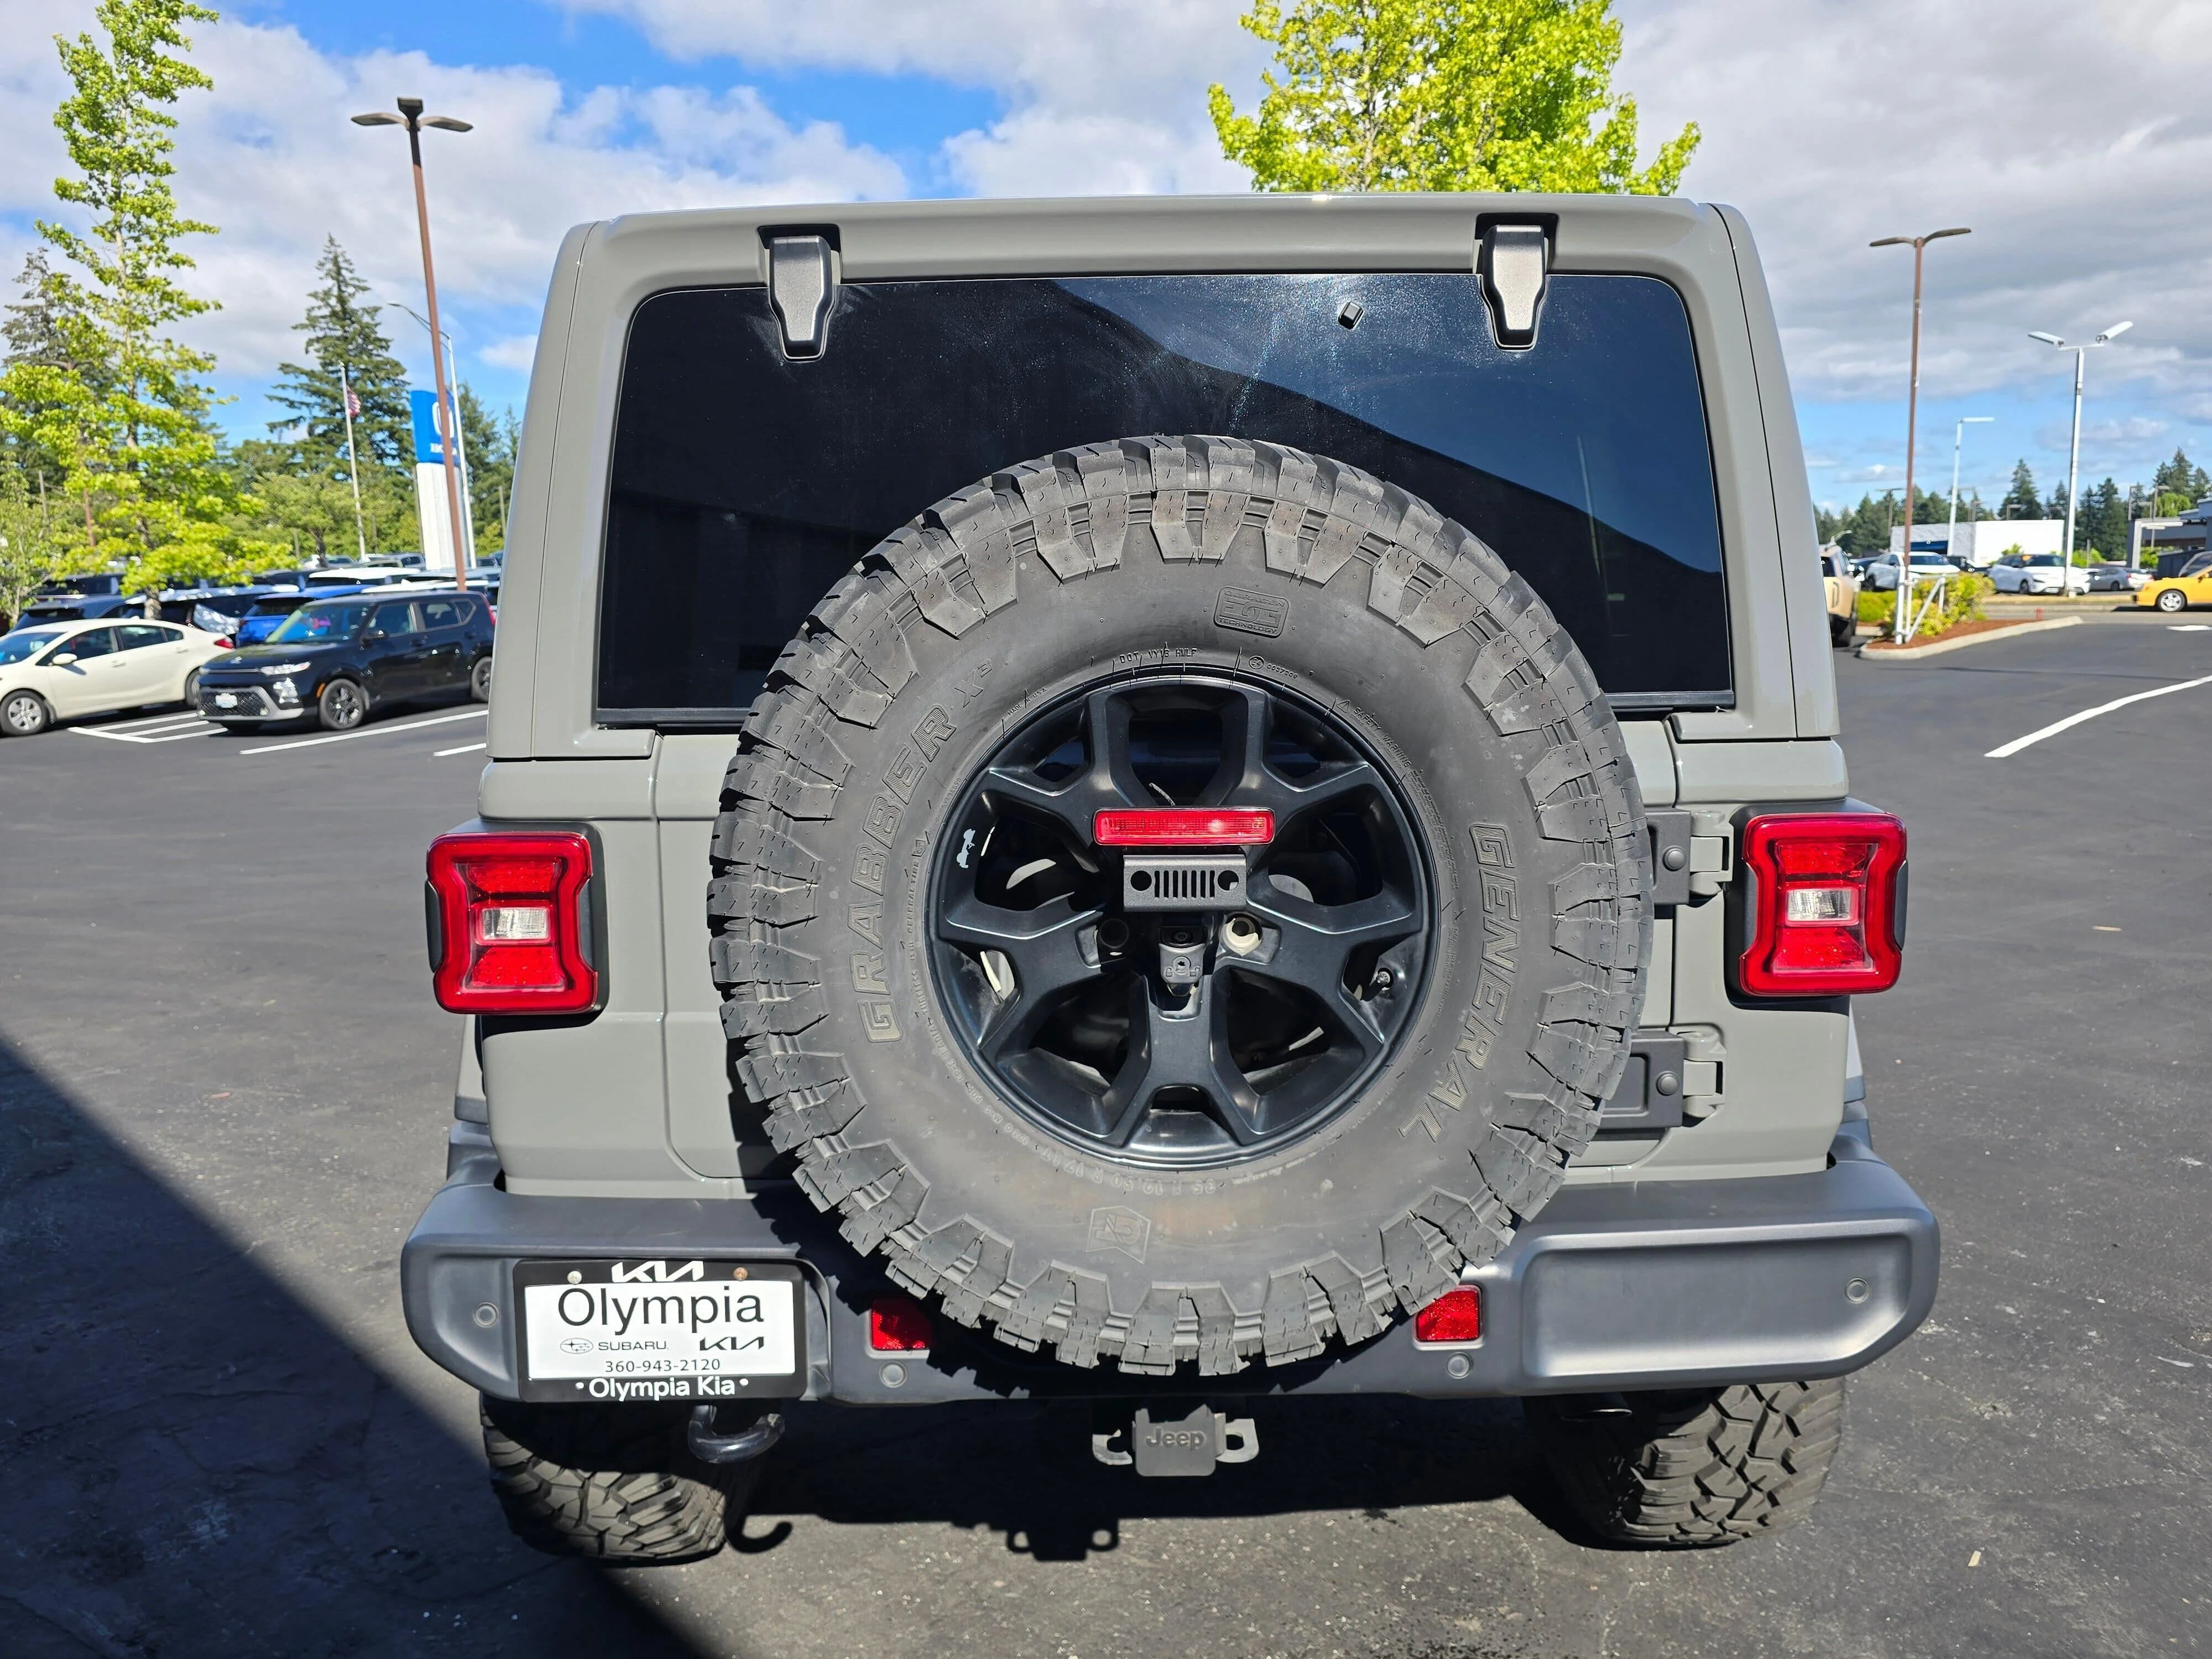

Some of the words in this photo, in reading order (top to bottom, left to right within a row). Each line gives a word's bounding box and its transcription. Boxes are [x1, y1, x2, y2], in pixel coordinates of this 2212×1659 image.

[1218, 617, 1278, 635] TECHNOLOGY
[1119, 651, 1140, 663] DOT
[1006, 702, 1022, 716] MADE
[1353, 707, 1382, 731] SAFETY
[1383, 735, 1412, 768] WARNING
[848, 704, 956, 1043] GRABBER
[1399, 822, 1520, 1142] GENERAL
[558, 1286, 764, 1335] Olympia
[605, 1359, 721, 1373] 360-943-2120
[589, 1377, 690, 1402] Olympia
[697, 1376, 735, 1396] Kia
[1145, 1426, 1206, 1451] Jeep
